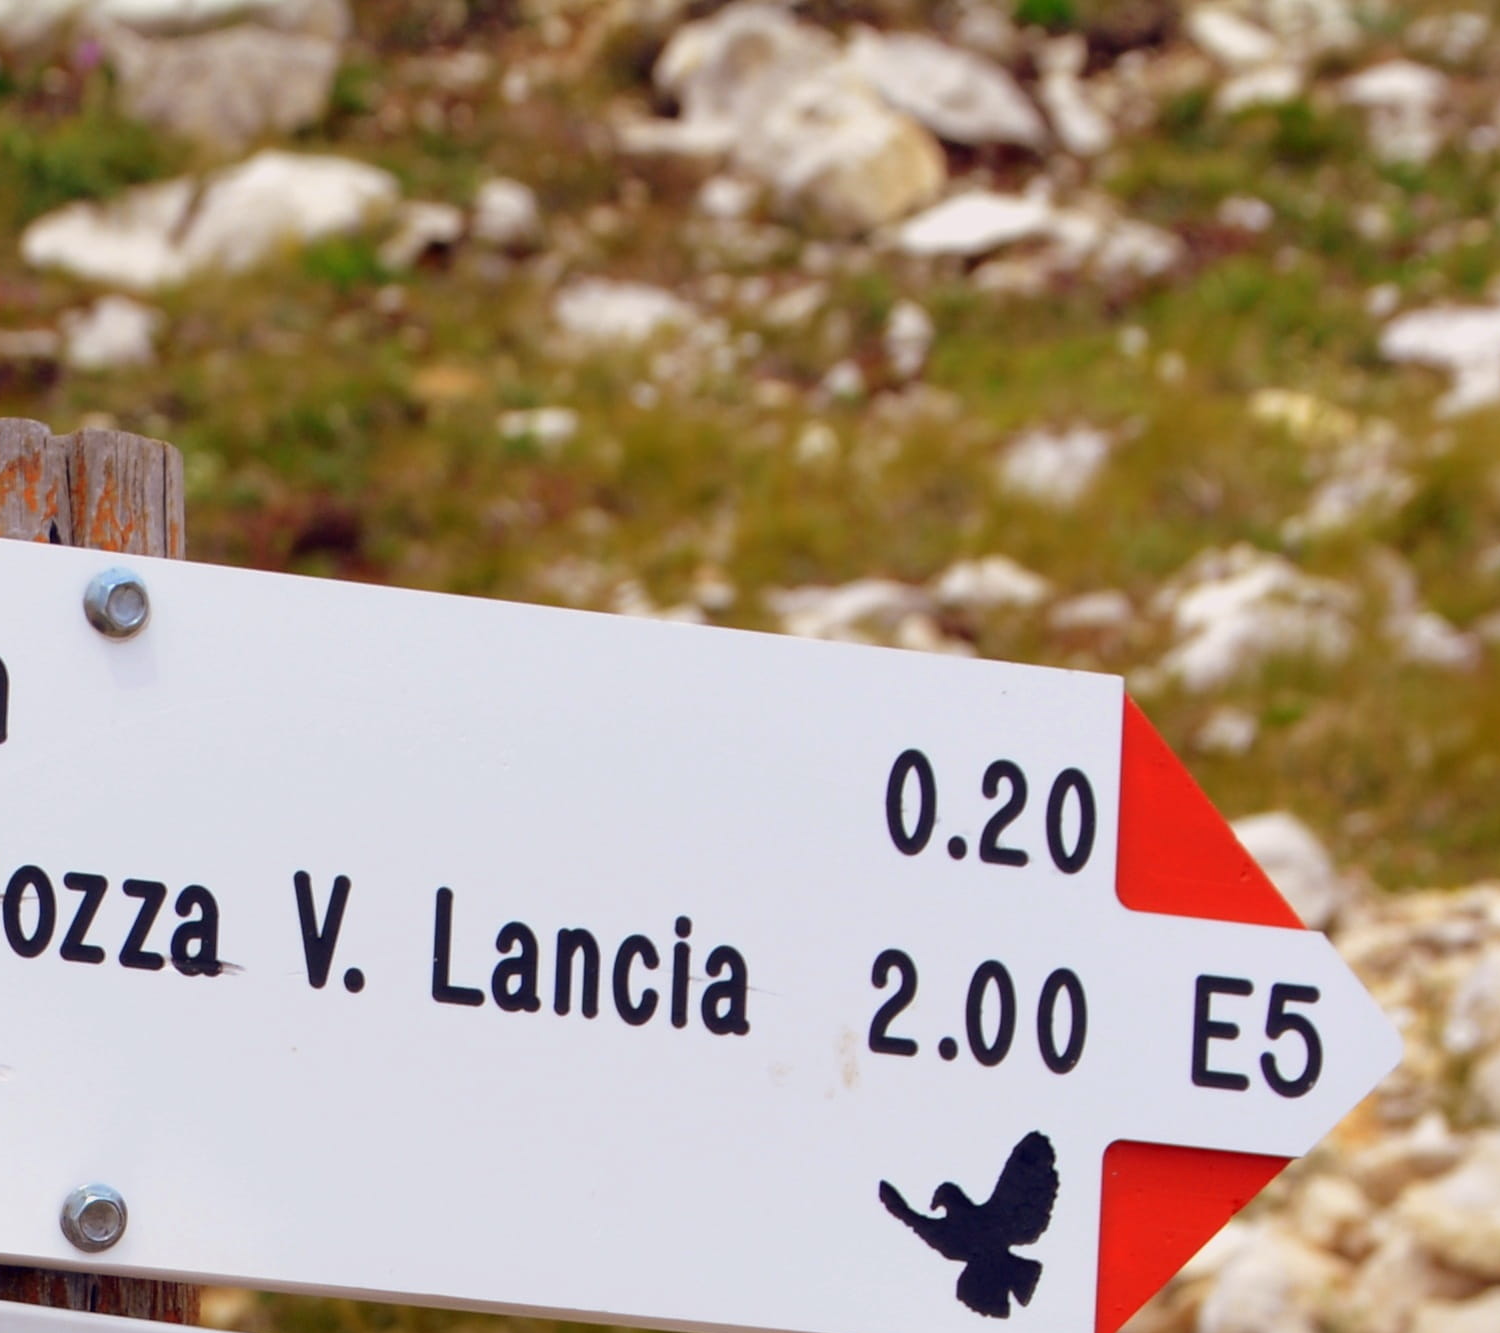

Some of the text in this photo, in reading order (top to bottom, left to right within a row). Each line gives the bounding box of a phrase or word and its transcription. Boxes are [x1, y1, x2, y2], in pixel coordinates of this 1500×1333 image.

[885, 748, 1097, 876] 0.20
[292, 869, 366, 994] V.
[430, 886, 751, 1037] Lancia
[867, 948, 1088, 1076] 2.00
[1190, 974, 1324, 1099] E5
